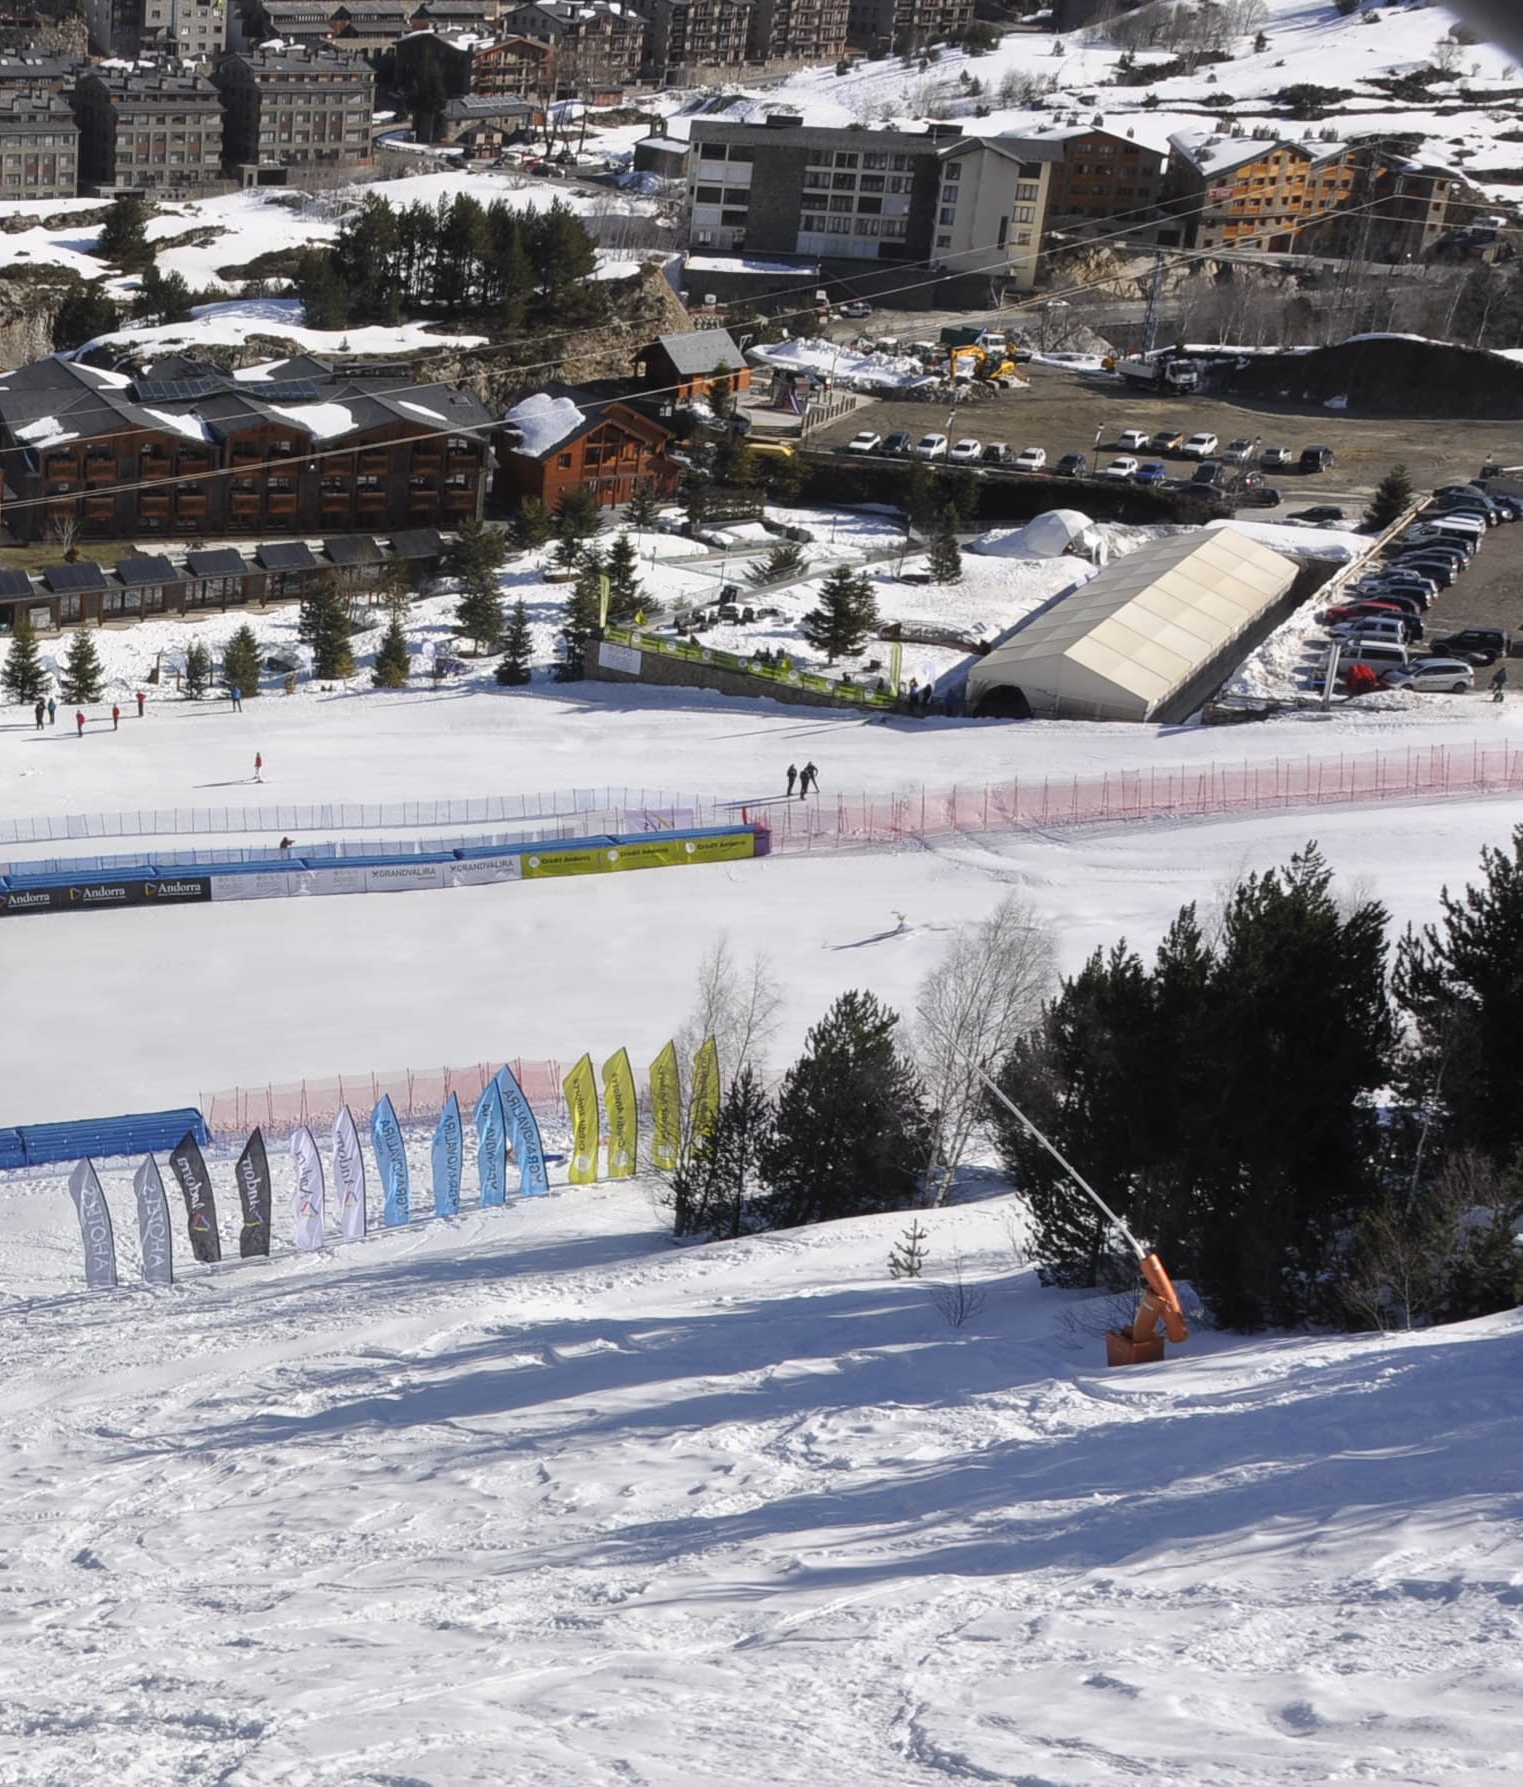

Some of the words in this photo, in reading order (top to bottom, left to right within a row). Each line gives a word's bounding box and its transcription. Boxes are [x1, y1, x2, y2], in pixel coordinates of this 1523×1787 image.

[456, 859, 513, 872] GRANDVALIRA
[378, 867, 436, 878] GRANDVALIRA
[83, 886, 126, 899] Andorra
[158, 880, 201, 894] Andorra
[8, 892, 50, 906] Andorra
